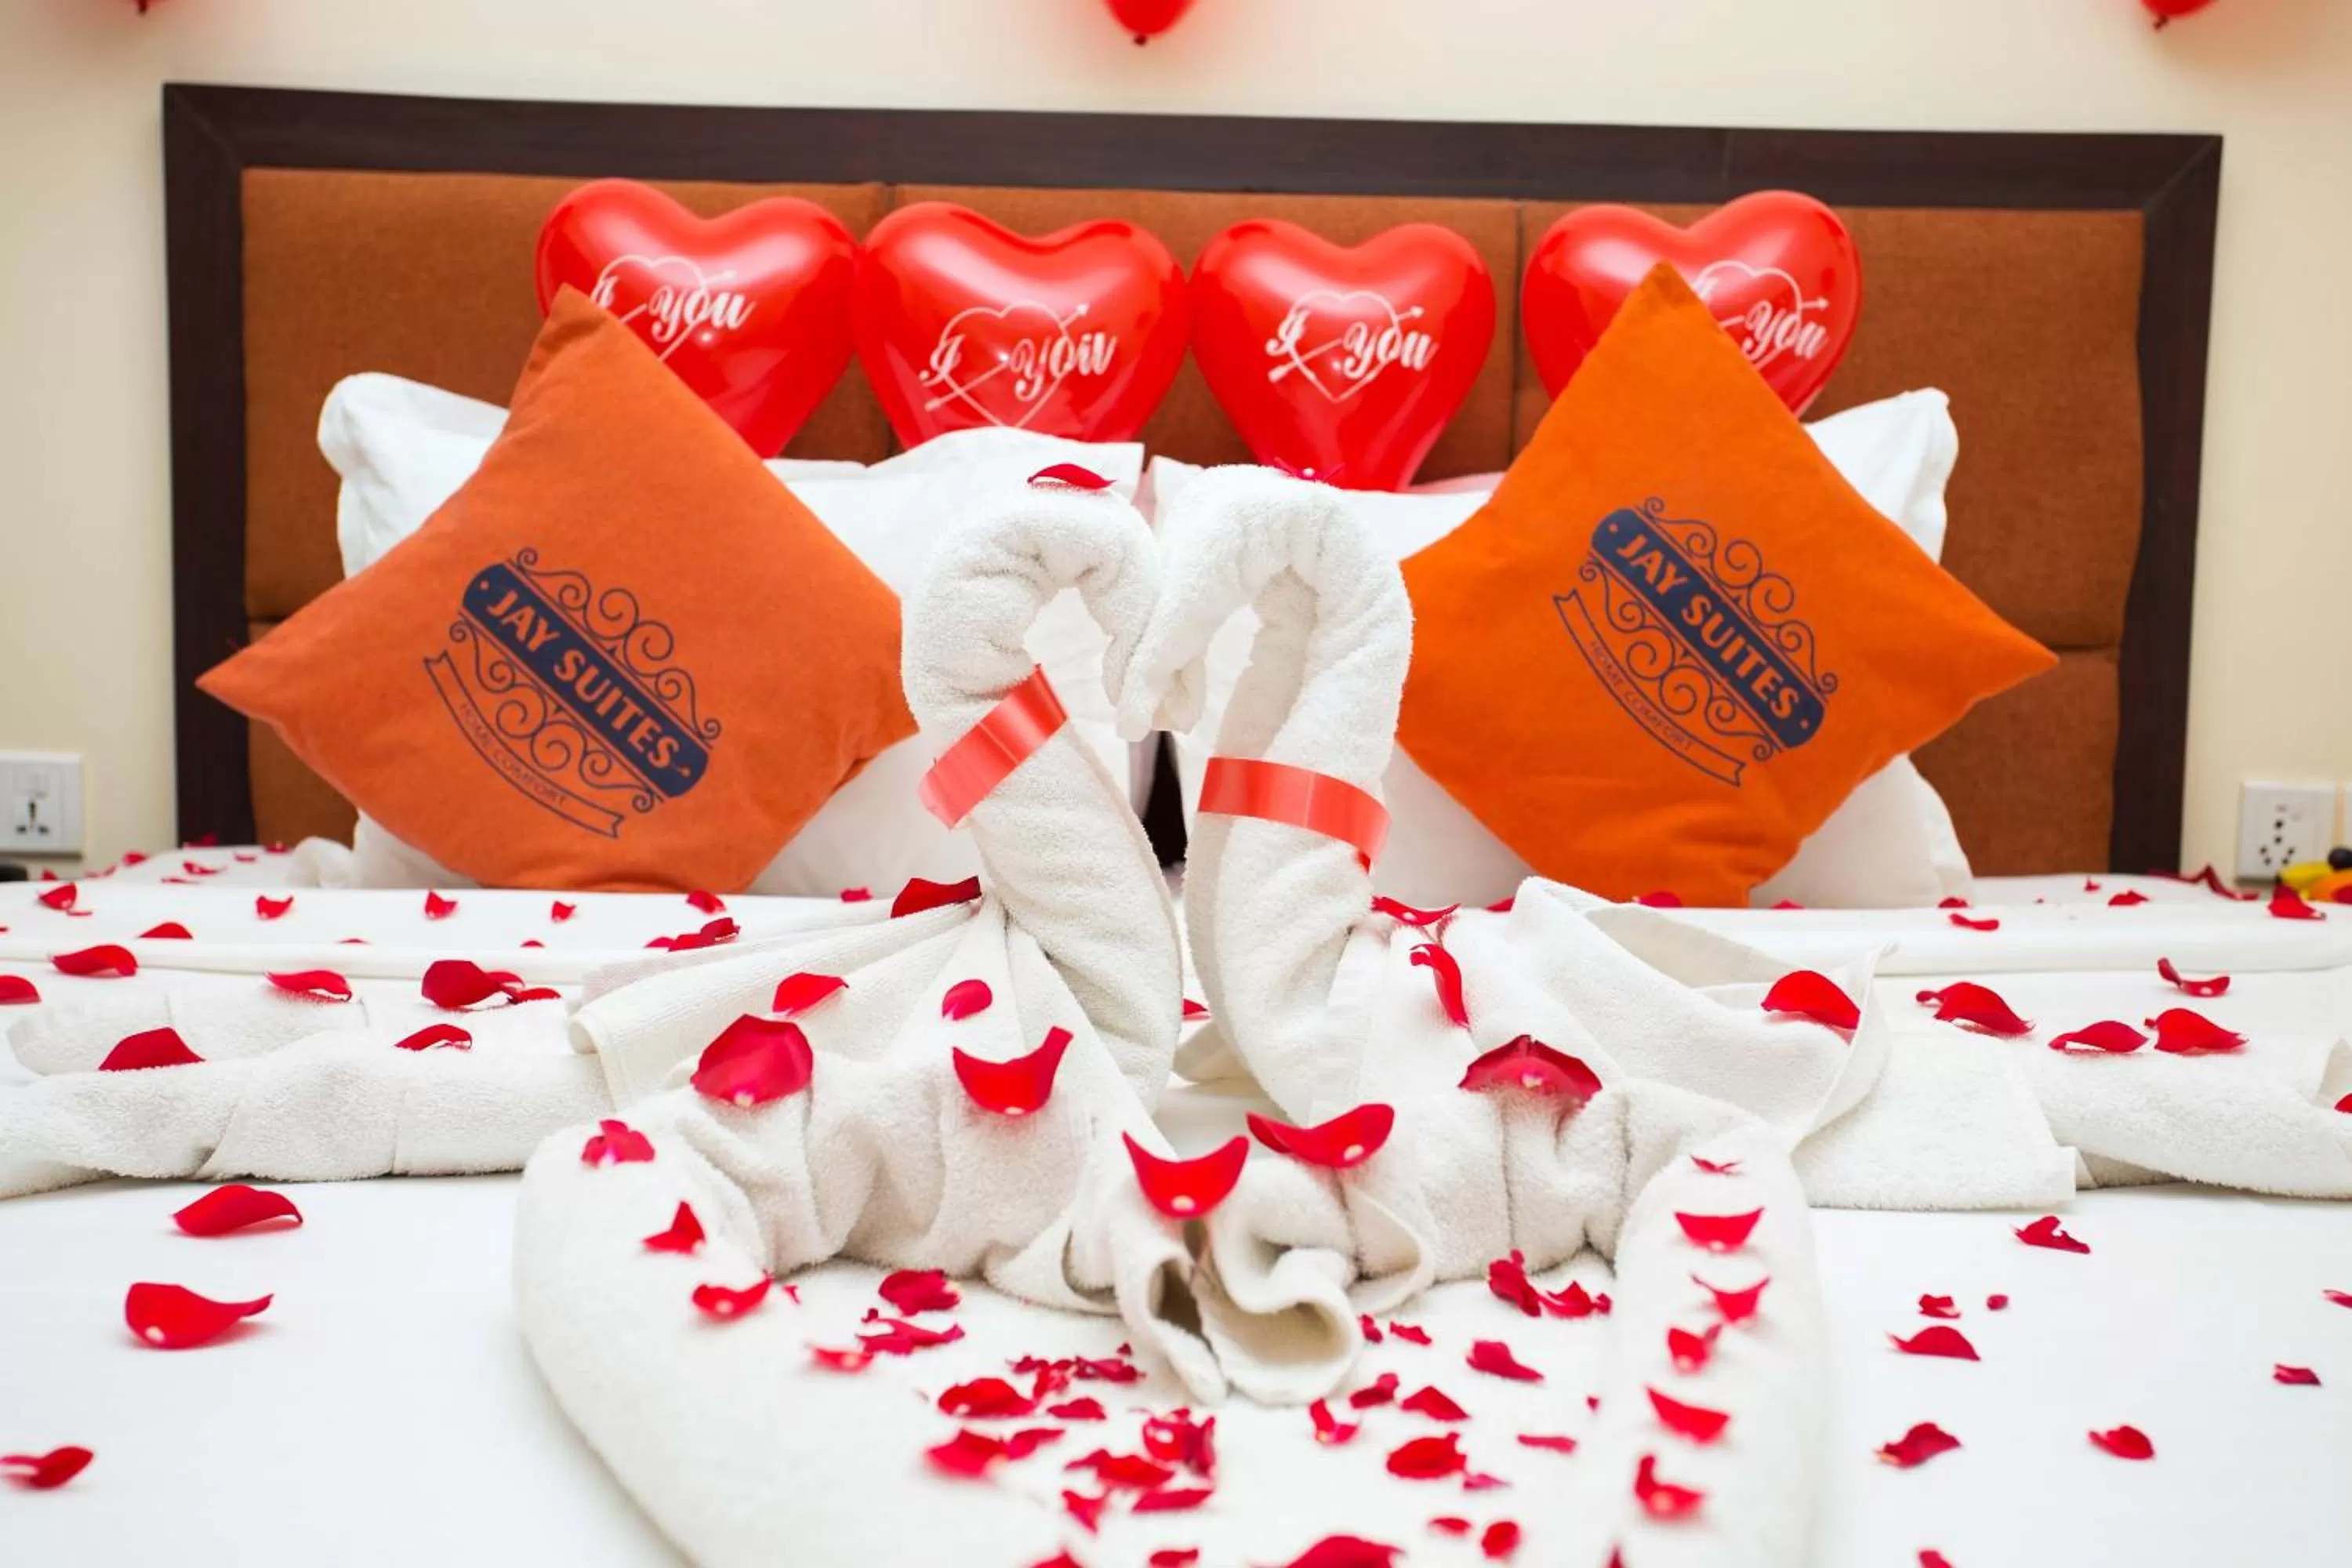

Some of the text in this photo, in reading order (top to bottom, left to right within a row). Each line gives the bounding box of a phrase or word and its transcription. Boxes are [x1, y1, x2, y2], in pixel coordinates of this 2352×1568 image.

[918, 334, 966, 387] I
[1265, 307, 1311, 357] I
[488, 591, 679, 768] JAY SUITES
[1617, 535, 1799, 718] JAY SUITES
